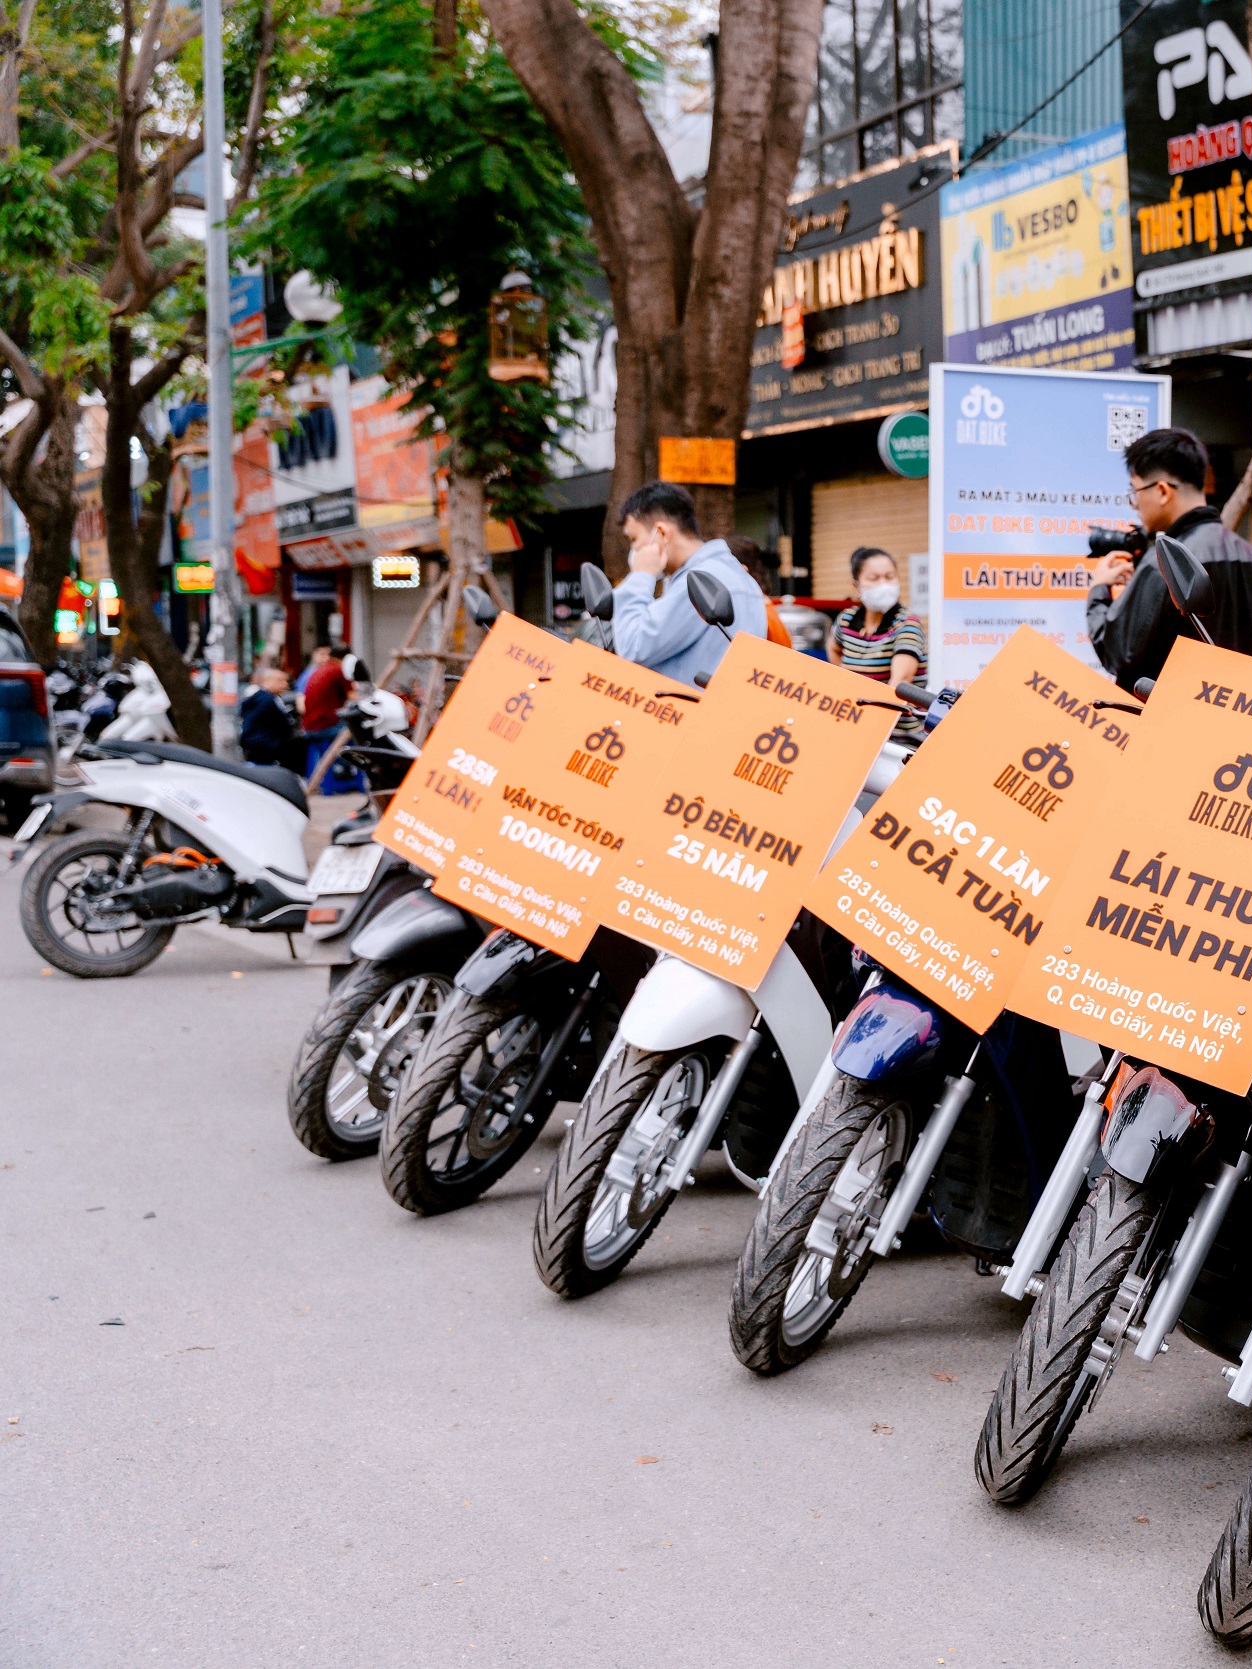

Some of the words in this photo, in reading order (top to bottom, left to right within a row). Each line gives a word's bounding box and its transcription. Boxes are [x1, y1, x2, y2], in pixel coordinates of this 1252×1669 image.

[1168, 118, 1242, 174] HOÀNG
[1017, 198, 1079, 242] VESBO
[1137, 176, 1194, 256] THIẾT
[1193, 191, 1219, 252] BỊ
[1057, 304, 1105, 342] LONG
[959, 489, 976, 501] RA
[948, 514, 988, 532] DAT
[992, 516, 1034, 534] BIKE
[965, 563, 997, 587] LÁI
[1003, 563, 1045, 588] THỬ
[504, 643, 521, 662] XE
[524, 652, 557, 674] MÁY
[581, 672, 605, 695] XE
[604, 685, 644, 709] MÁY
[643, 701, 684, 726] ĐIỆN
[747, 668, 776, 691] XE
[773, 682, 819, 707] MÁY
[817, 699, 863, 725] ĐIỆN
[1023, 670, 1054, 701] XE
[1053, 692, 1107, 730] MÁY
[1194, 680, 1233, 709] XE
[733, 753, 793, 795] DAT.BIKE
[993, 765, 1063, 822] DAT.BIKE
[498, 815, 602, 878] 100KM/H
[502, 785, 537, 813] VẬN
[537, 803, 573, 828] TỐC
[575, 816, 602, 843] TỐI
[599, 833, 625, 852] ĐA
[663, 792, 706, 829] ĐỘ
[704, 808, 758, 847] BỀN
[755, 832, 803, 866] PIN
[918, 797, 977, 845] SẠC
[976, 835, 994, 858] 1
[989, 841, 1050, 897] LẦN
[666, 834, 704, 864] 25
[702, 847, 769, 892] NĂM
[869, 811, 911, 851] ĐI
[907, 839, 959, 885] CẢ
[956, 869, 1044, 946] TUẦN
[1109, 849, 1182, 899] LÁI
[837, 895, 851, 914] Q.
[854, 902, 886, 936] Cầu
[886, 926, 921, 968] Giấy,
[923, 956, 946, 982] Hà
[946, 974, 975, 1002] Nội
[838, 867, 871, 896] 283
[871, 889, 921, 936] Hoàng
[922, 925, 961, 962] Quốc
[963, 952, 995, 991] Việt,
[1086, 895, 1191, 957] MIỄN
[1041, 955, 1080, 982] 283
[1081, 970, 1145, 1008] Hoàng
[1147, 990, 1197, 1022] Quốc
[1202, 1010, 1244, 1044] Việt,
[1047, 985, 1065, 1007] Q.
[1070, 993, 1108, 1022] Cầu
[1109, 1008, 1154, 1043] Giấy,
[1158, 1024, 1188, 1048] Hà
[1189, 1037, 1226, 1063] Nội
